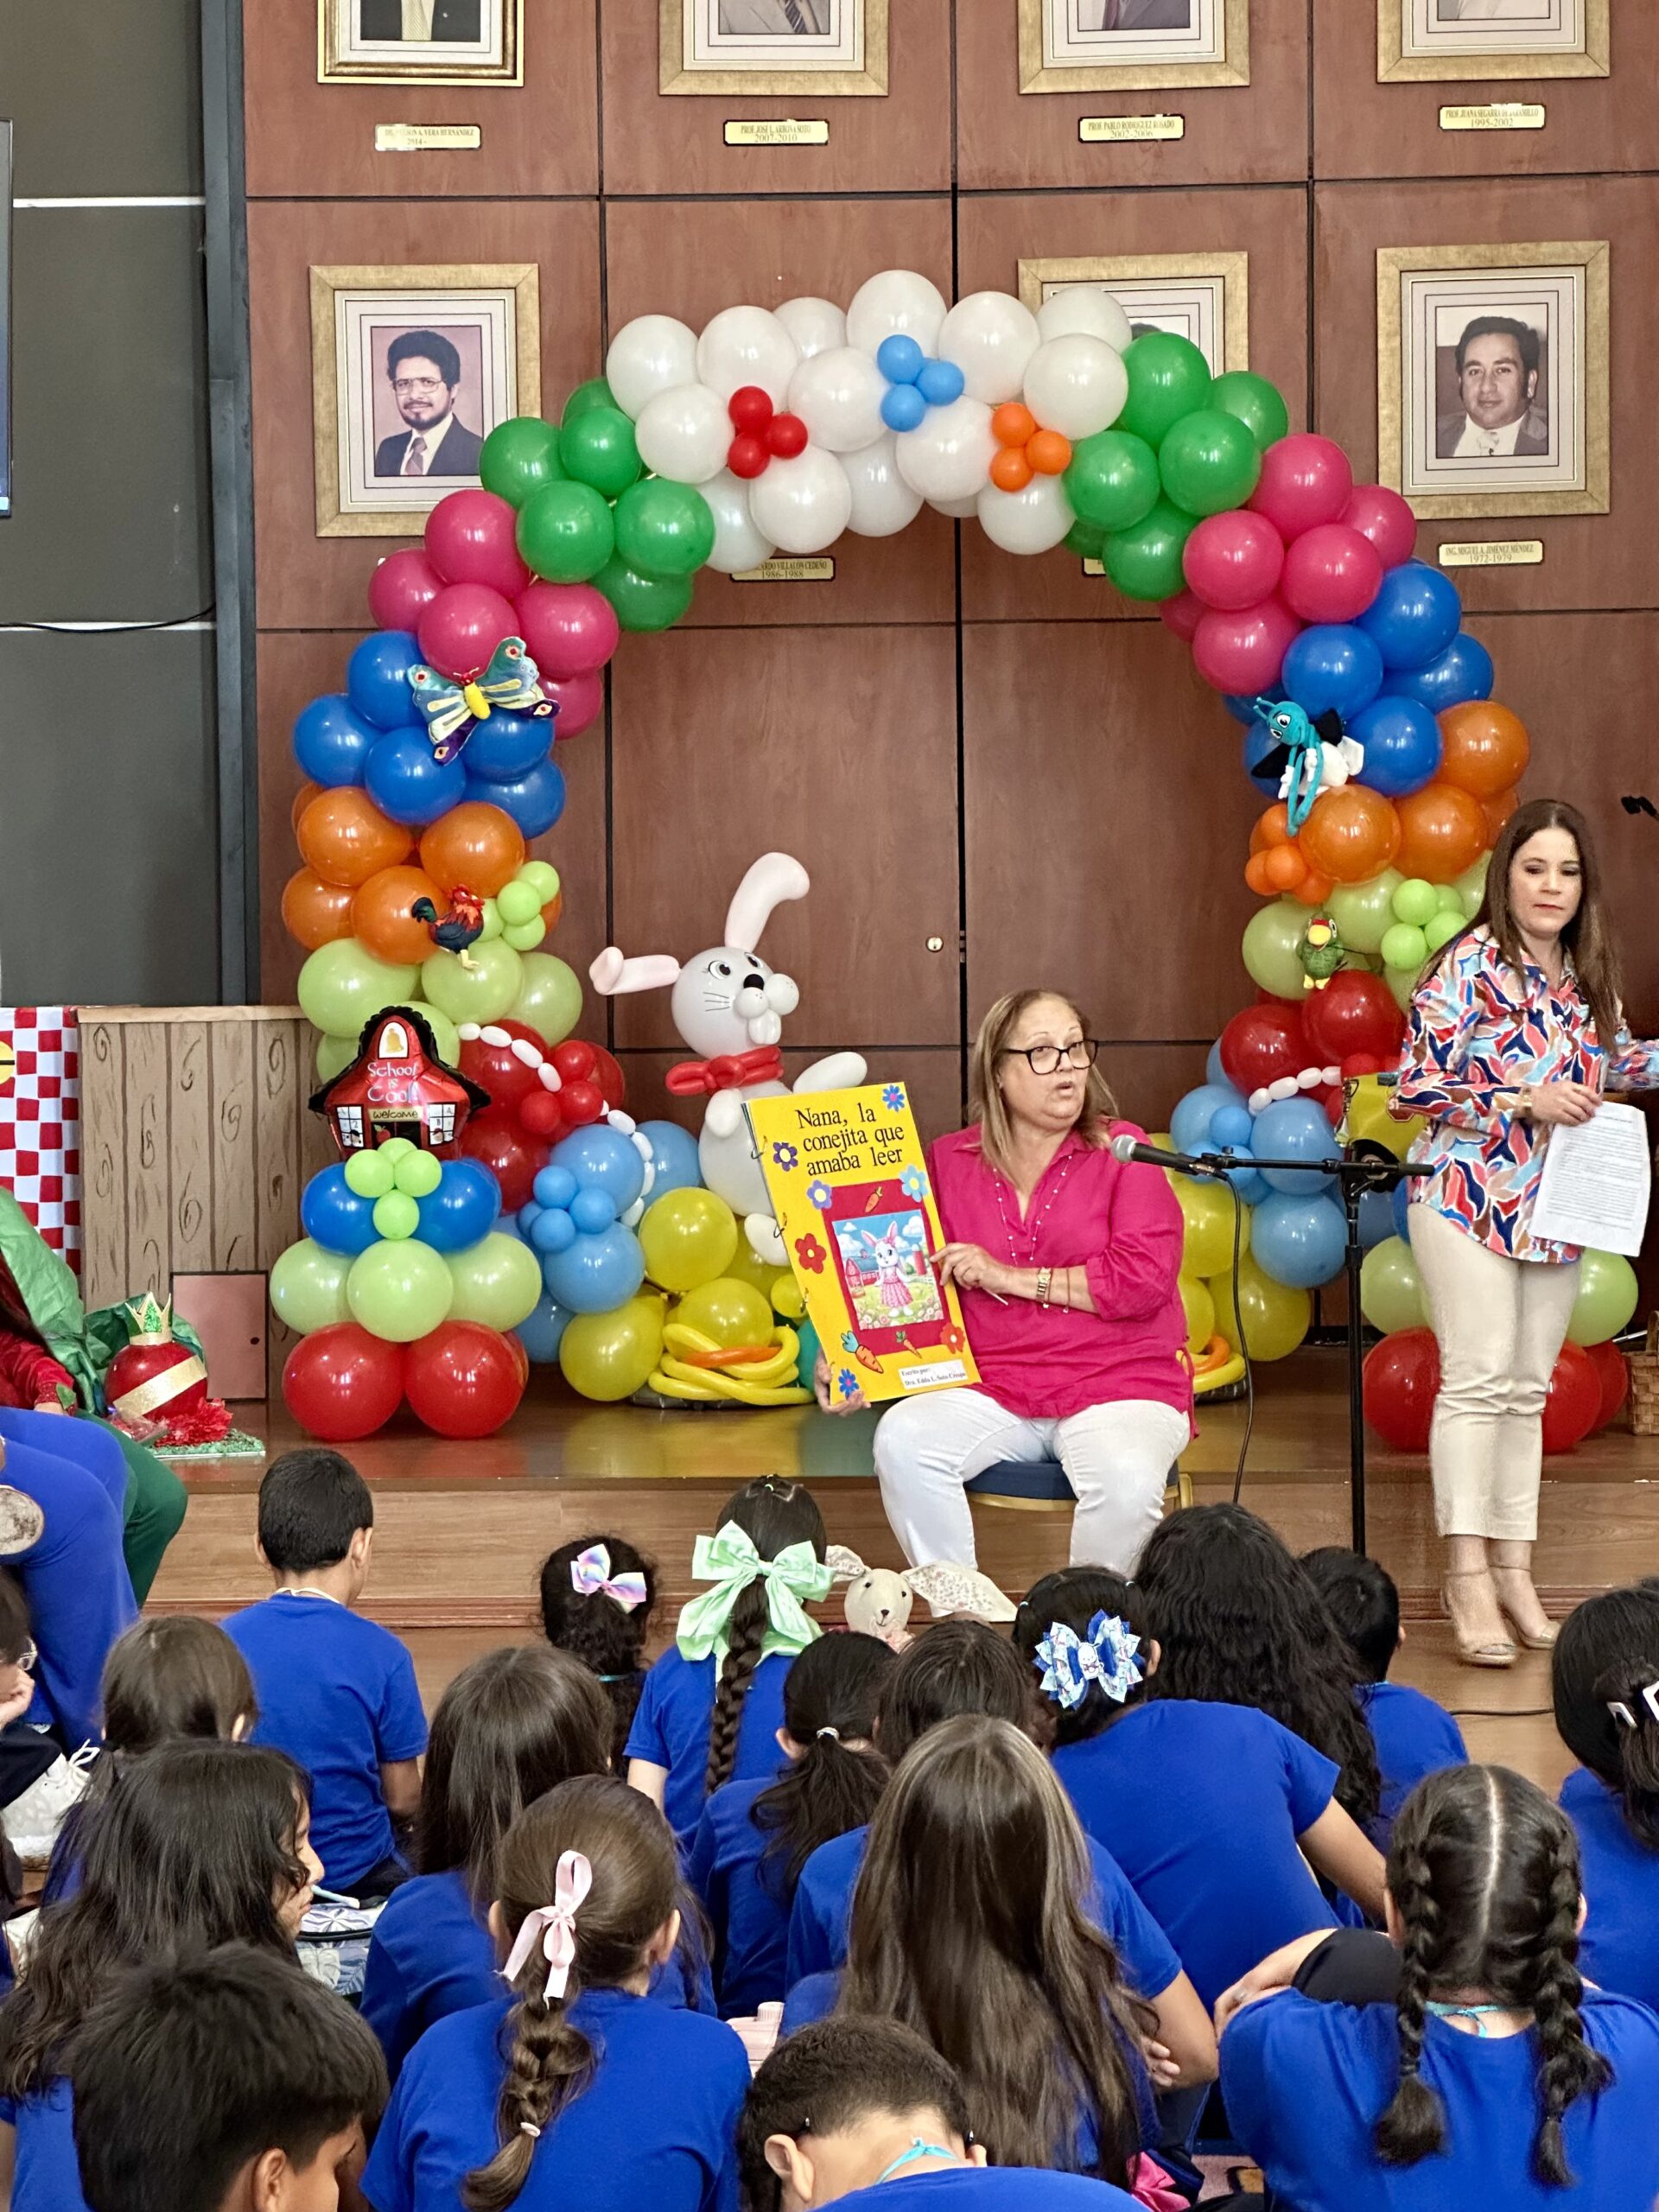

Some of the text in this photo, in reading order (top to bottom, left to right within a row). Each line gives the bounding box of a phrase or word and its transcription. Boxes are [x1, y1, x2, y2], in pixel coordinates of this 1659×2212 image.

[1460, 110, 1478, 118] JUANA
[1103, 121, 1121, 130] PABLO
[1471, 118, 1514, 127] 1995-2002
[754, 134, 798, 143] 2007-2010
[1109, 130, 1154, 138] 2002-2006
[1470, 554, 1513, 563] 1972-1979
[761, 570, 804, 579] 1986-1988
[367, 1061, 418, 1077] School
[388, 1078, 398, 1088] is
[372, 1110, 418, 1119] welcome
[795, 1103, 876, 1128] Nana, la
[803, 1125, 905, 1153] conejita que
[806, 1147, 903, 1176] amaba leer
